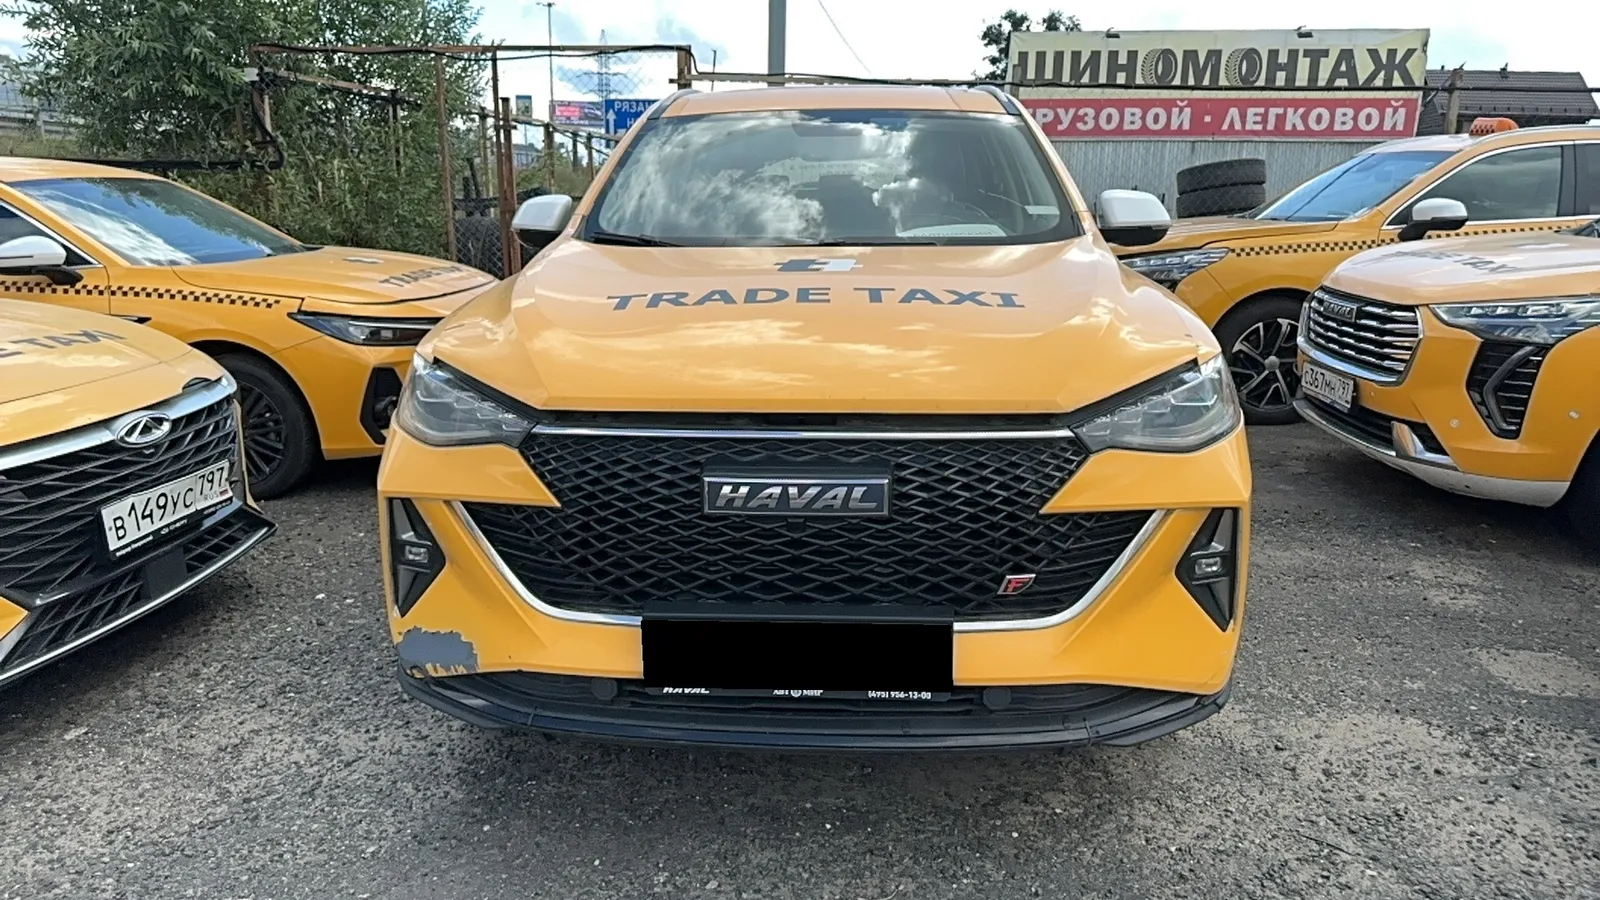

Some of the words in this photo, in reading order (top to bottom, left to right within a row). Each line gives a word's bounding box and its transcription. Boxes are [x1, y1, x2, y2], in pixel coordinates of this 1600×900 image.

[1014, 47, 1418, 87] ШИНОМОНТАЖ
[1028, 100, 1192, 131] РУЗОВОЙ
[1221, 99, 1407, 131] ЛЕГКОВОЙ
[606, 287, 832, 311] TRADE
[853, 287, 1026, 308] TAXI
[113, 487, 195, 542] В149УС
[198, 466, 226, 497] 797
[714, 484, 880, 509] HAVAL
